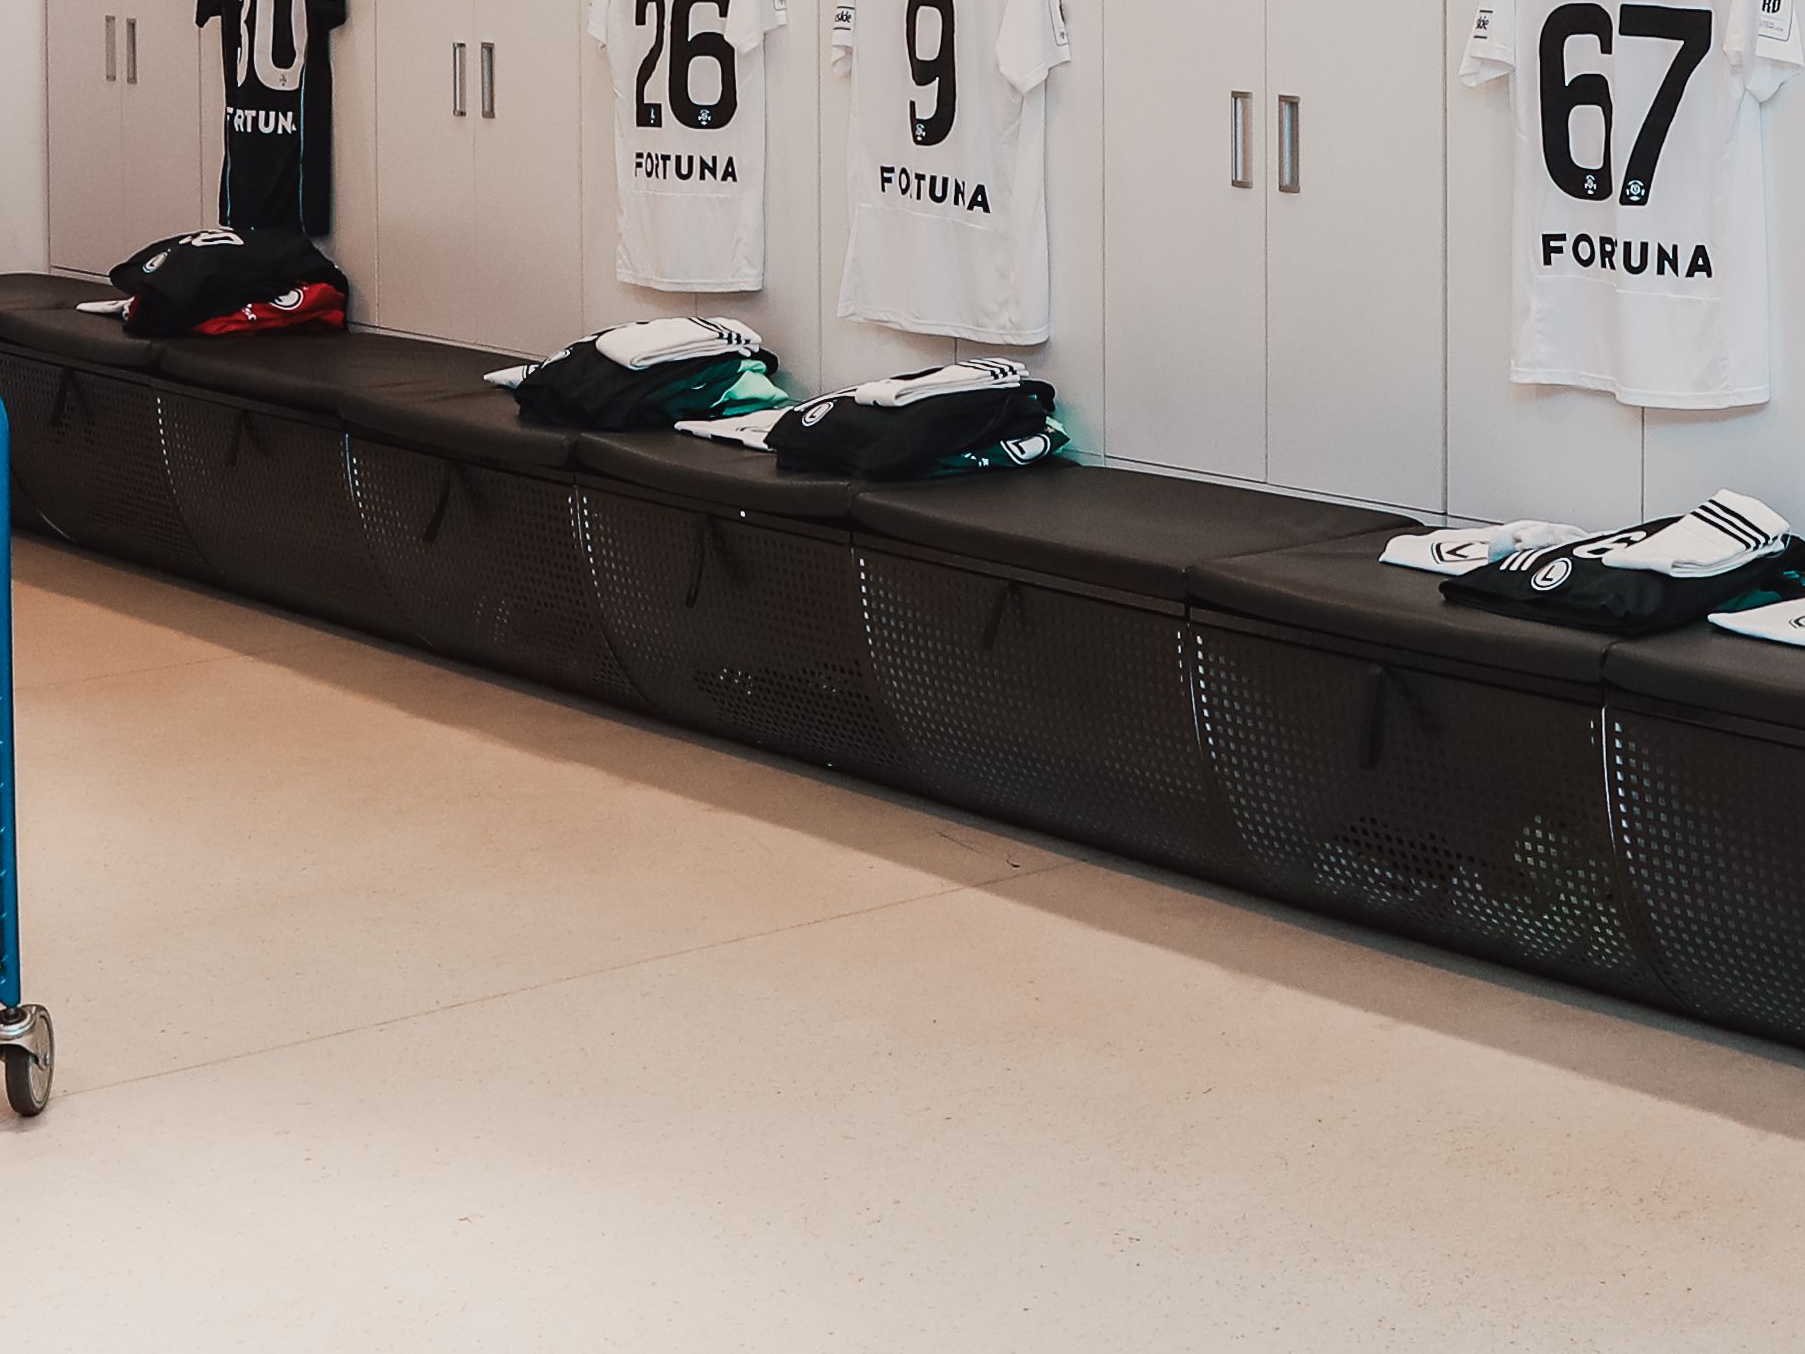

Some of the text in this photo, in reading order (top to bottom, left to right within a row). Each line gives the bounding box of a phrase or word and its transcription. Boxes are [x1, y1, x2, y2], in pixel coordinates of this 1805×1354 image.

[1539, 3, 1713, 206] 67
[880, 165, 991, 214] FOTUNA
[1541, 233, 1712, 278] FORUNA
